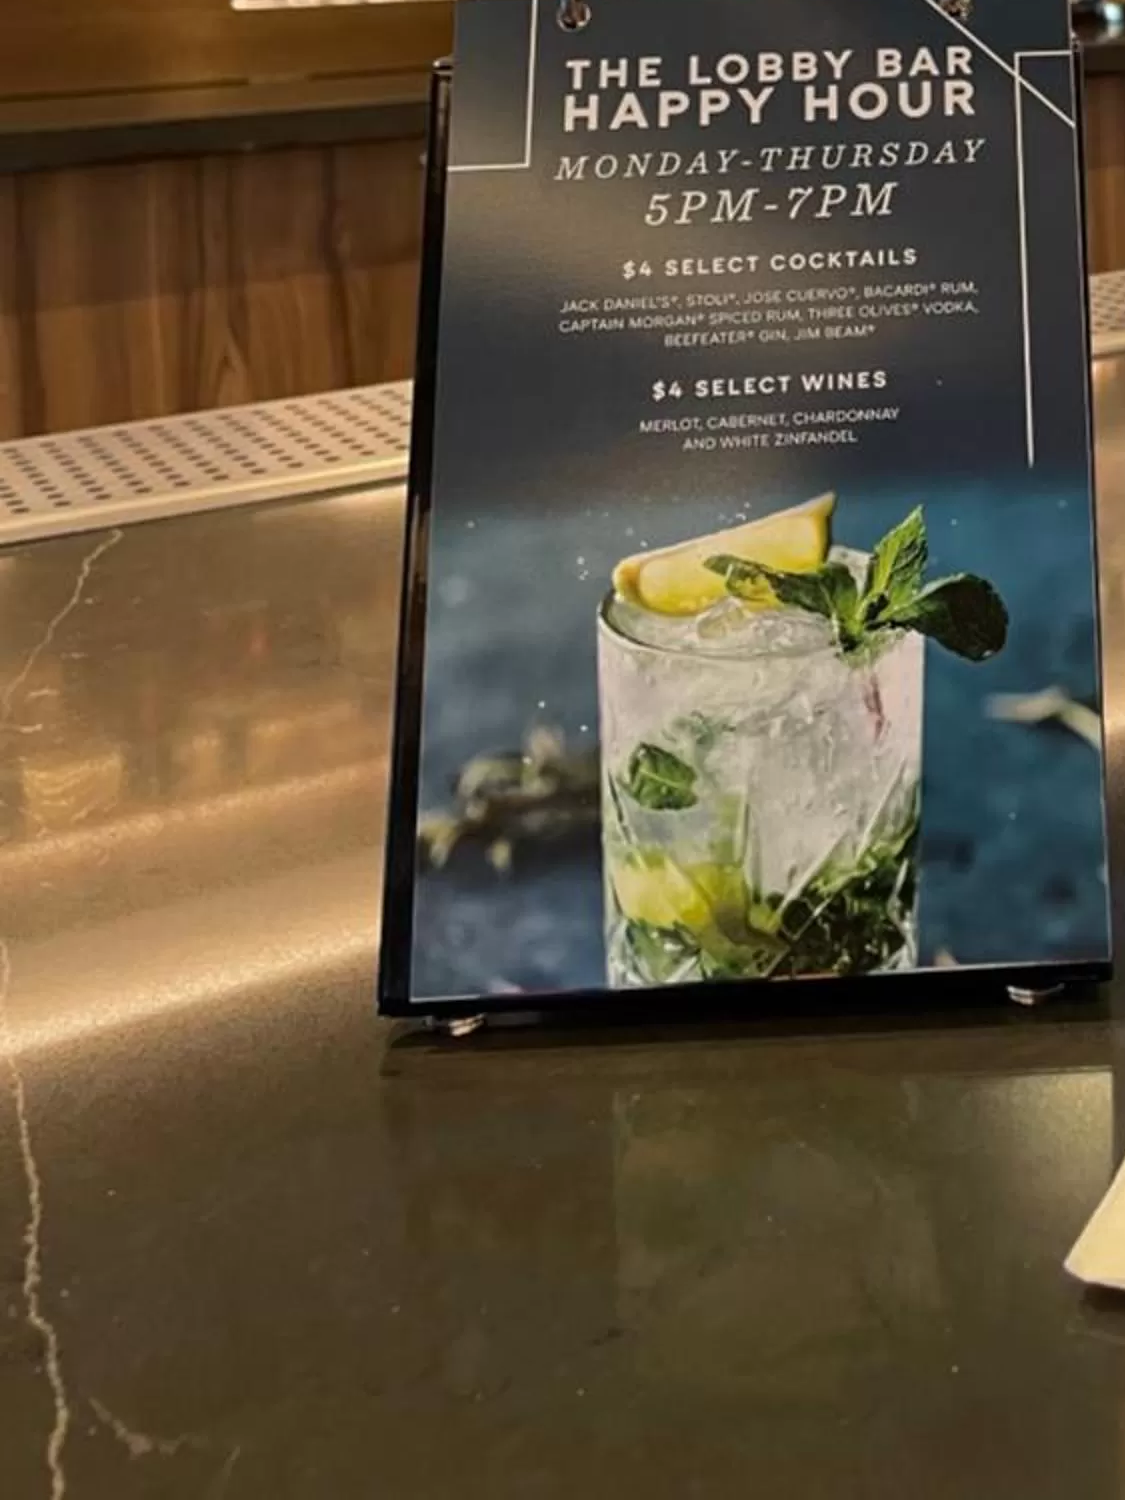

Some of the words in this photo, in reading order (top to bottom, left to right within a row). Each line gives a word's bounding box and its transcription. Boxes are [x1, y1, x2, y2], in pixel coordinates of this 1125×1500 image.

[566, 57, 663, 90] THE
[689, 49, 853, 86] LOBBY
[877, 45, 974, 78] BAR
[563, 86, 775, 132] HAPPY
[804, 80, 976, 123] HOUR
[553, 138, 986, 181] MONDAY-THURSDAY
[644, 182, 898, 227] 5PM-7PM
[622, 259, 652, 279] $4
[665, 254, 760, 277] SELECT
[770, 248, 917, 271] COCKTAILS
[560, 299, 599, 313] JACK
[744, 289, 782, 305] JOSE
[940, 281, 979, 295] RUM,
[559, 317, 625, 333] CAPTAIN
[709, 311, 762, 326] SPICED
[766, 309, 804, 322] RUM,
[807, 306, 854, 320] THREE
[922, 300, 980, 315] VODKA,
[758, 329, 790, 343] GIN,
[794, 326, 821, 341] JIM
[652, 379, 684, 401] $4
[695, 375, 791, 398] SELECT
[801, 370, 888, 392] WINES
[639, 418, 703, 434] MERLOT,
[706, 412, 790, 431] CABERNET,
[792, 407, 901, 426] CHARDONNAY
[682, 437, 716, 451] AND
[720, 434, 769, 449] WHITE
[774, 430, 858, 447] ZINFANDEL
